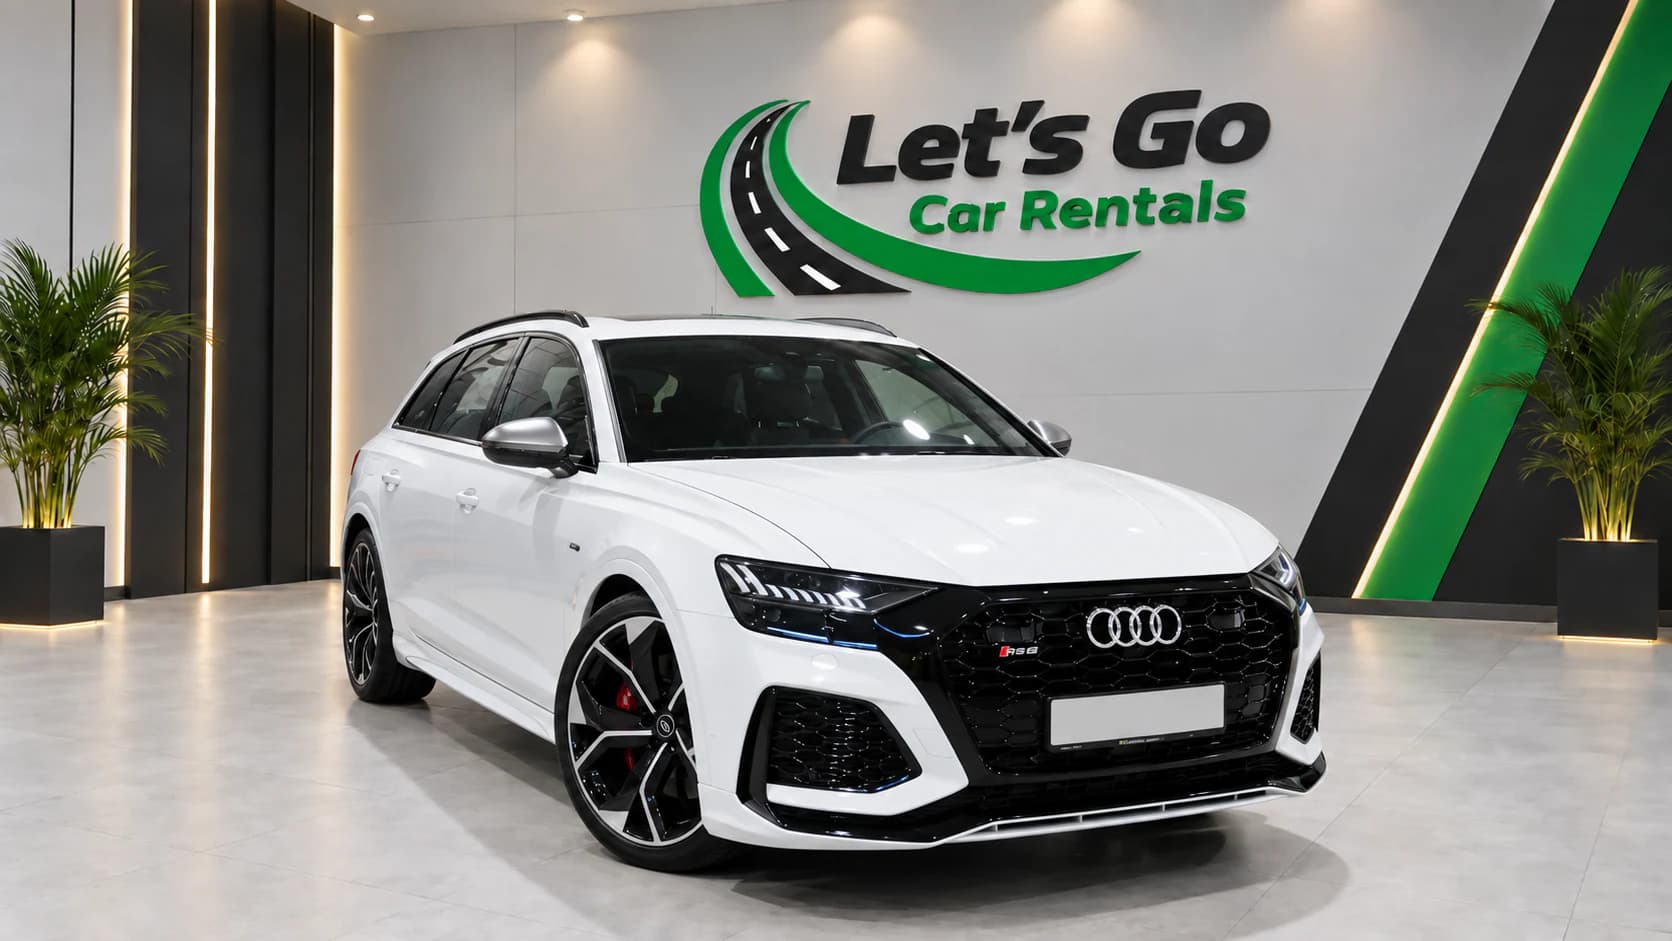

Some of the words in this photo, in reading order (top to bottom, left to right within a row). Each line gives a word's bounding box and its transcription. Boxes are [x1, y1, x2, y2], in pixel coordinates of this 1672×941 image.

[837, 100, 1089, 185] Let's
[1113, 90, 1270, 169] Go
[910, 195, 1006, 234] Car
[1020, 180, 1245, 230] Rentals
